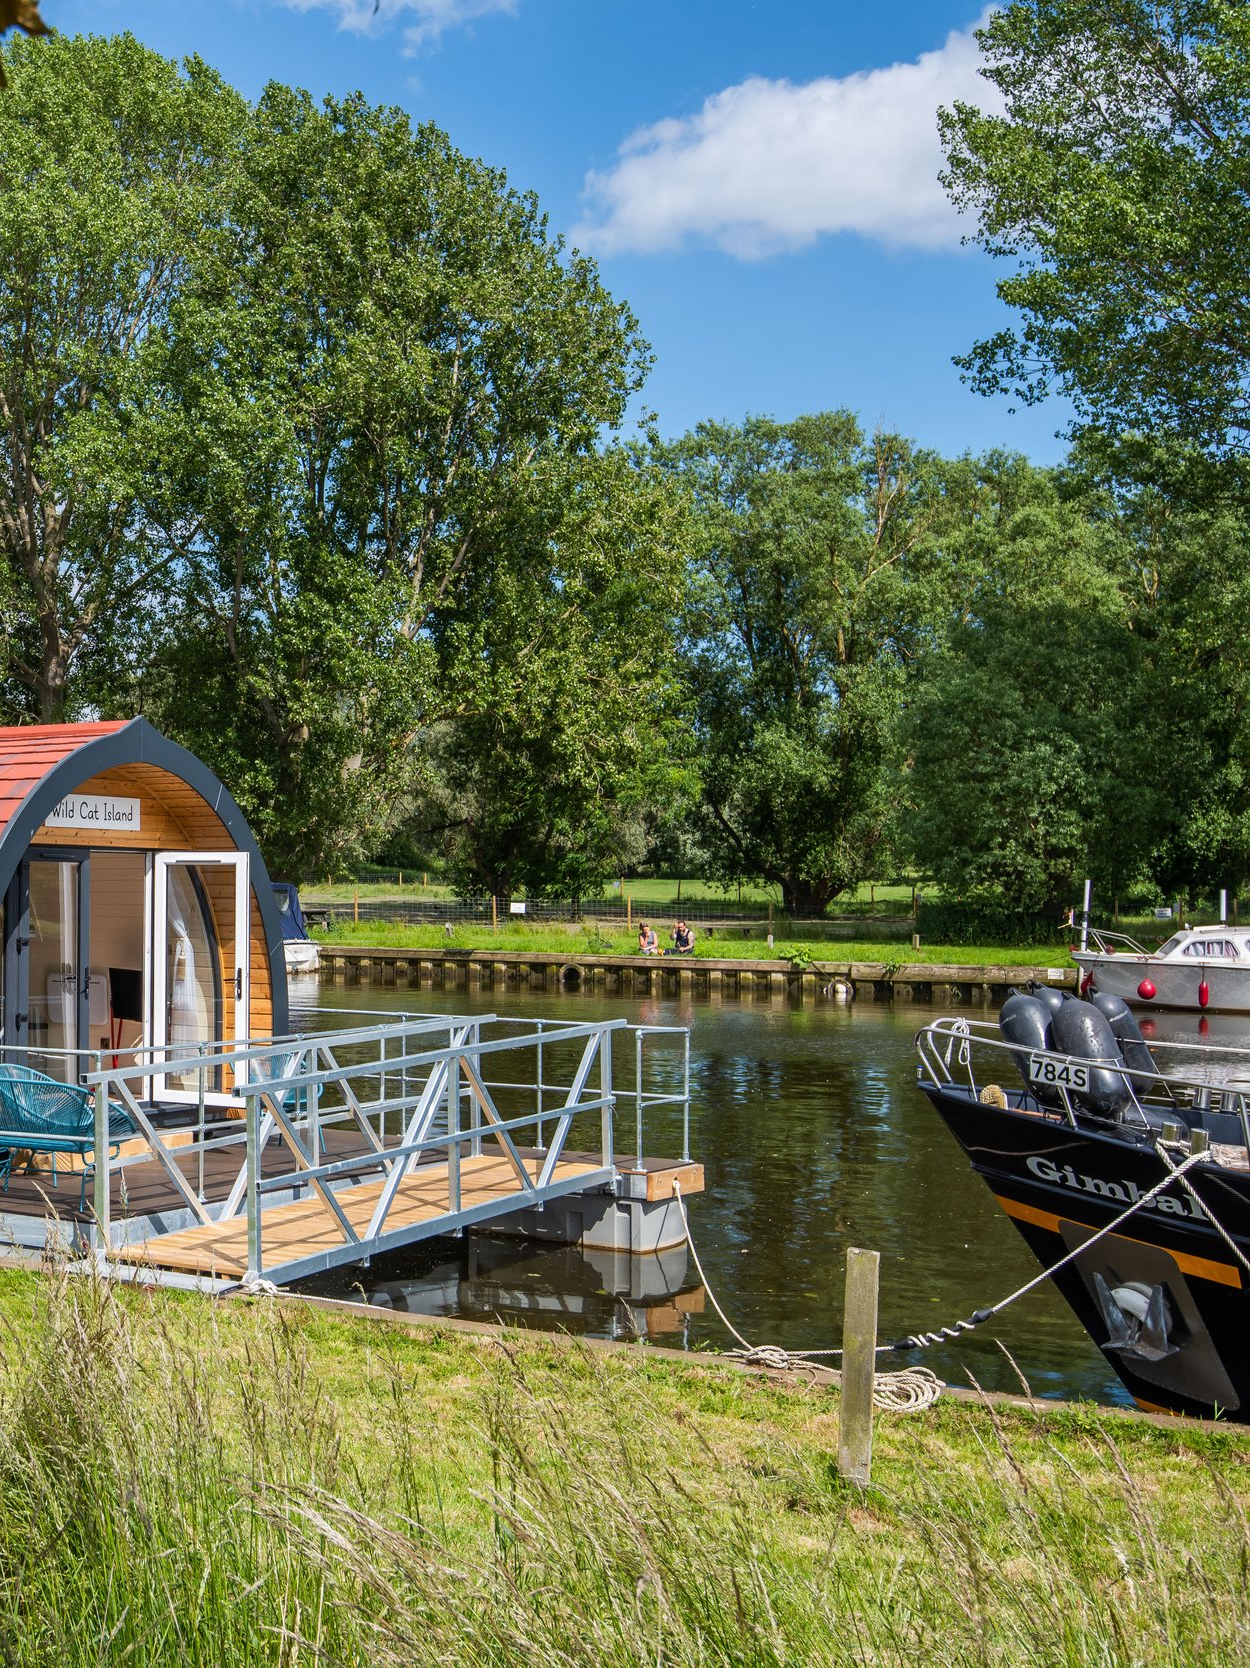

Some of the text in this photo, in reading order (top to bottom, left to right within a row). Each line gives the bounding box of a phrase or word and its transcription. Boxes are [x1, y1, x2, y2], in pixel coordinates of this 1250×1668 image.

[52, 800, 133, 822] Wild Cat Island
[1031, 1059, 1087, 1088] 784S
[1026, 1156, 1210, 1221] Gimbal
